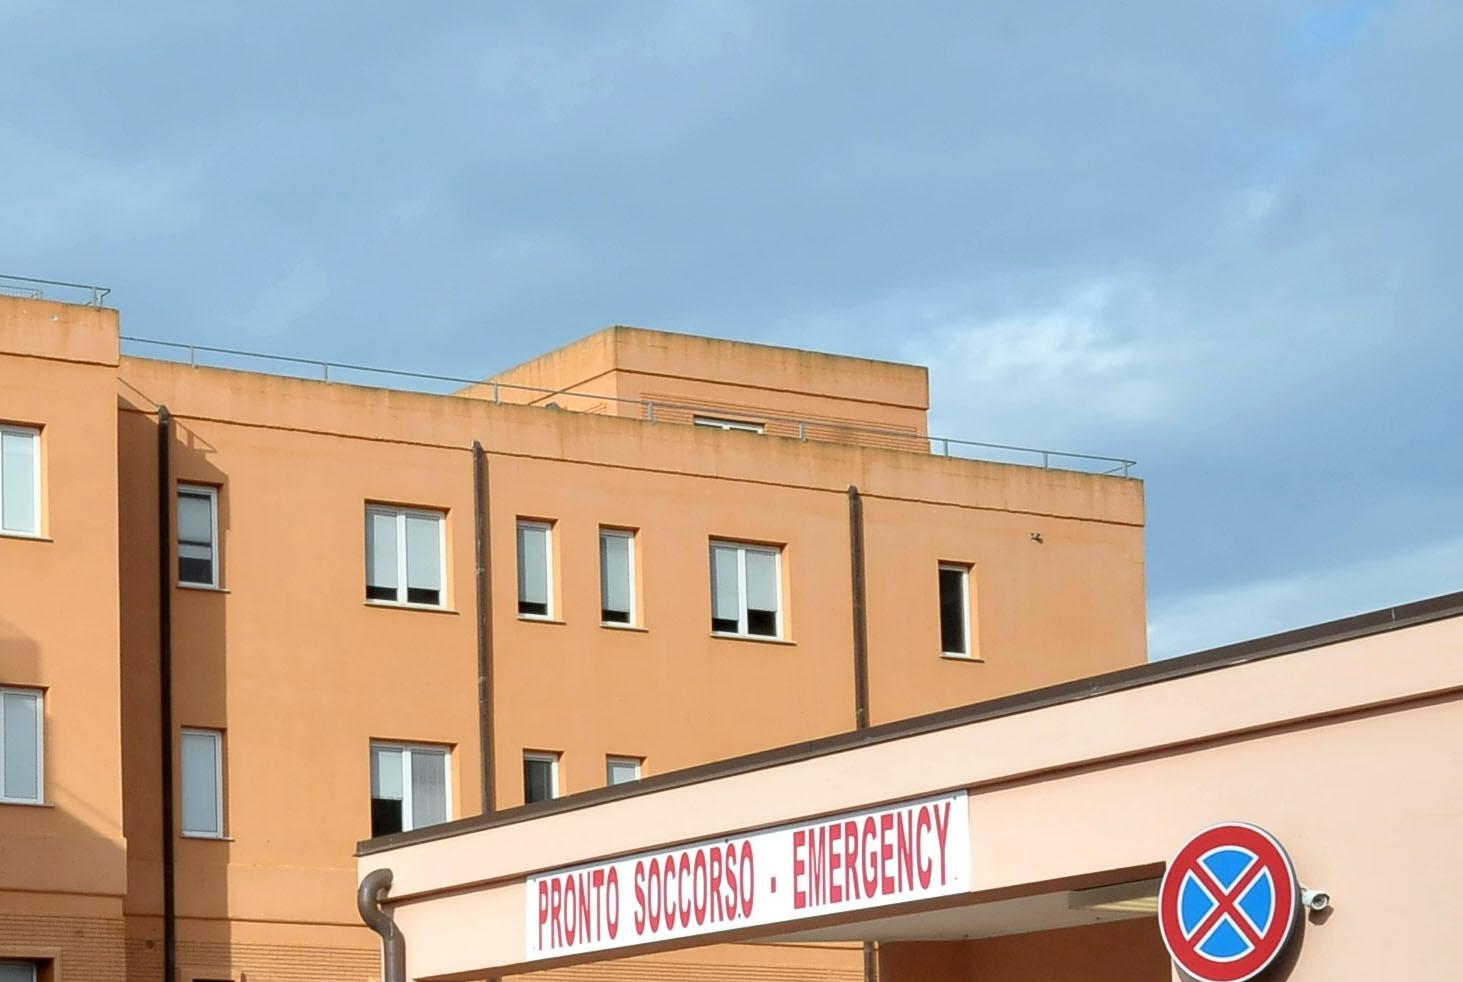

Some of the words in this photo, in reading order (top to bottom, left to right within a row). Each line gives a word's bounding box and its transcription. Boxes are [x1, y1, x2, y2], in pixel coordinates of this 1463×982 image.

[538, 866, 620, 951] PRONTO
[634, 839, 756, 937] SOCCORSO
[770, 876, 778, 893] -
[792, 801, 953, 910] EMERGENCY
